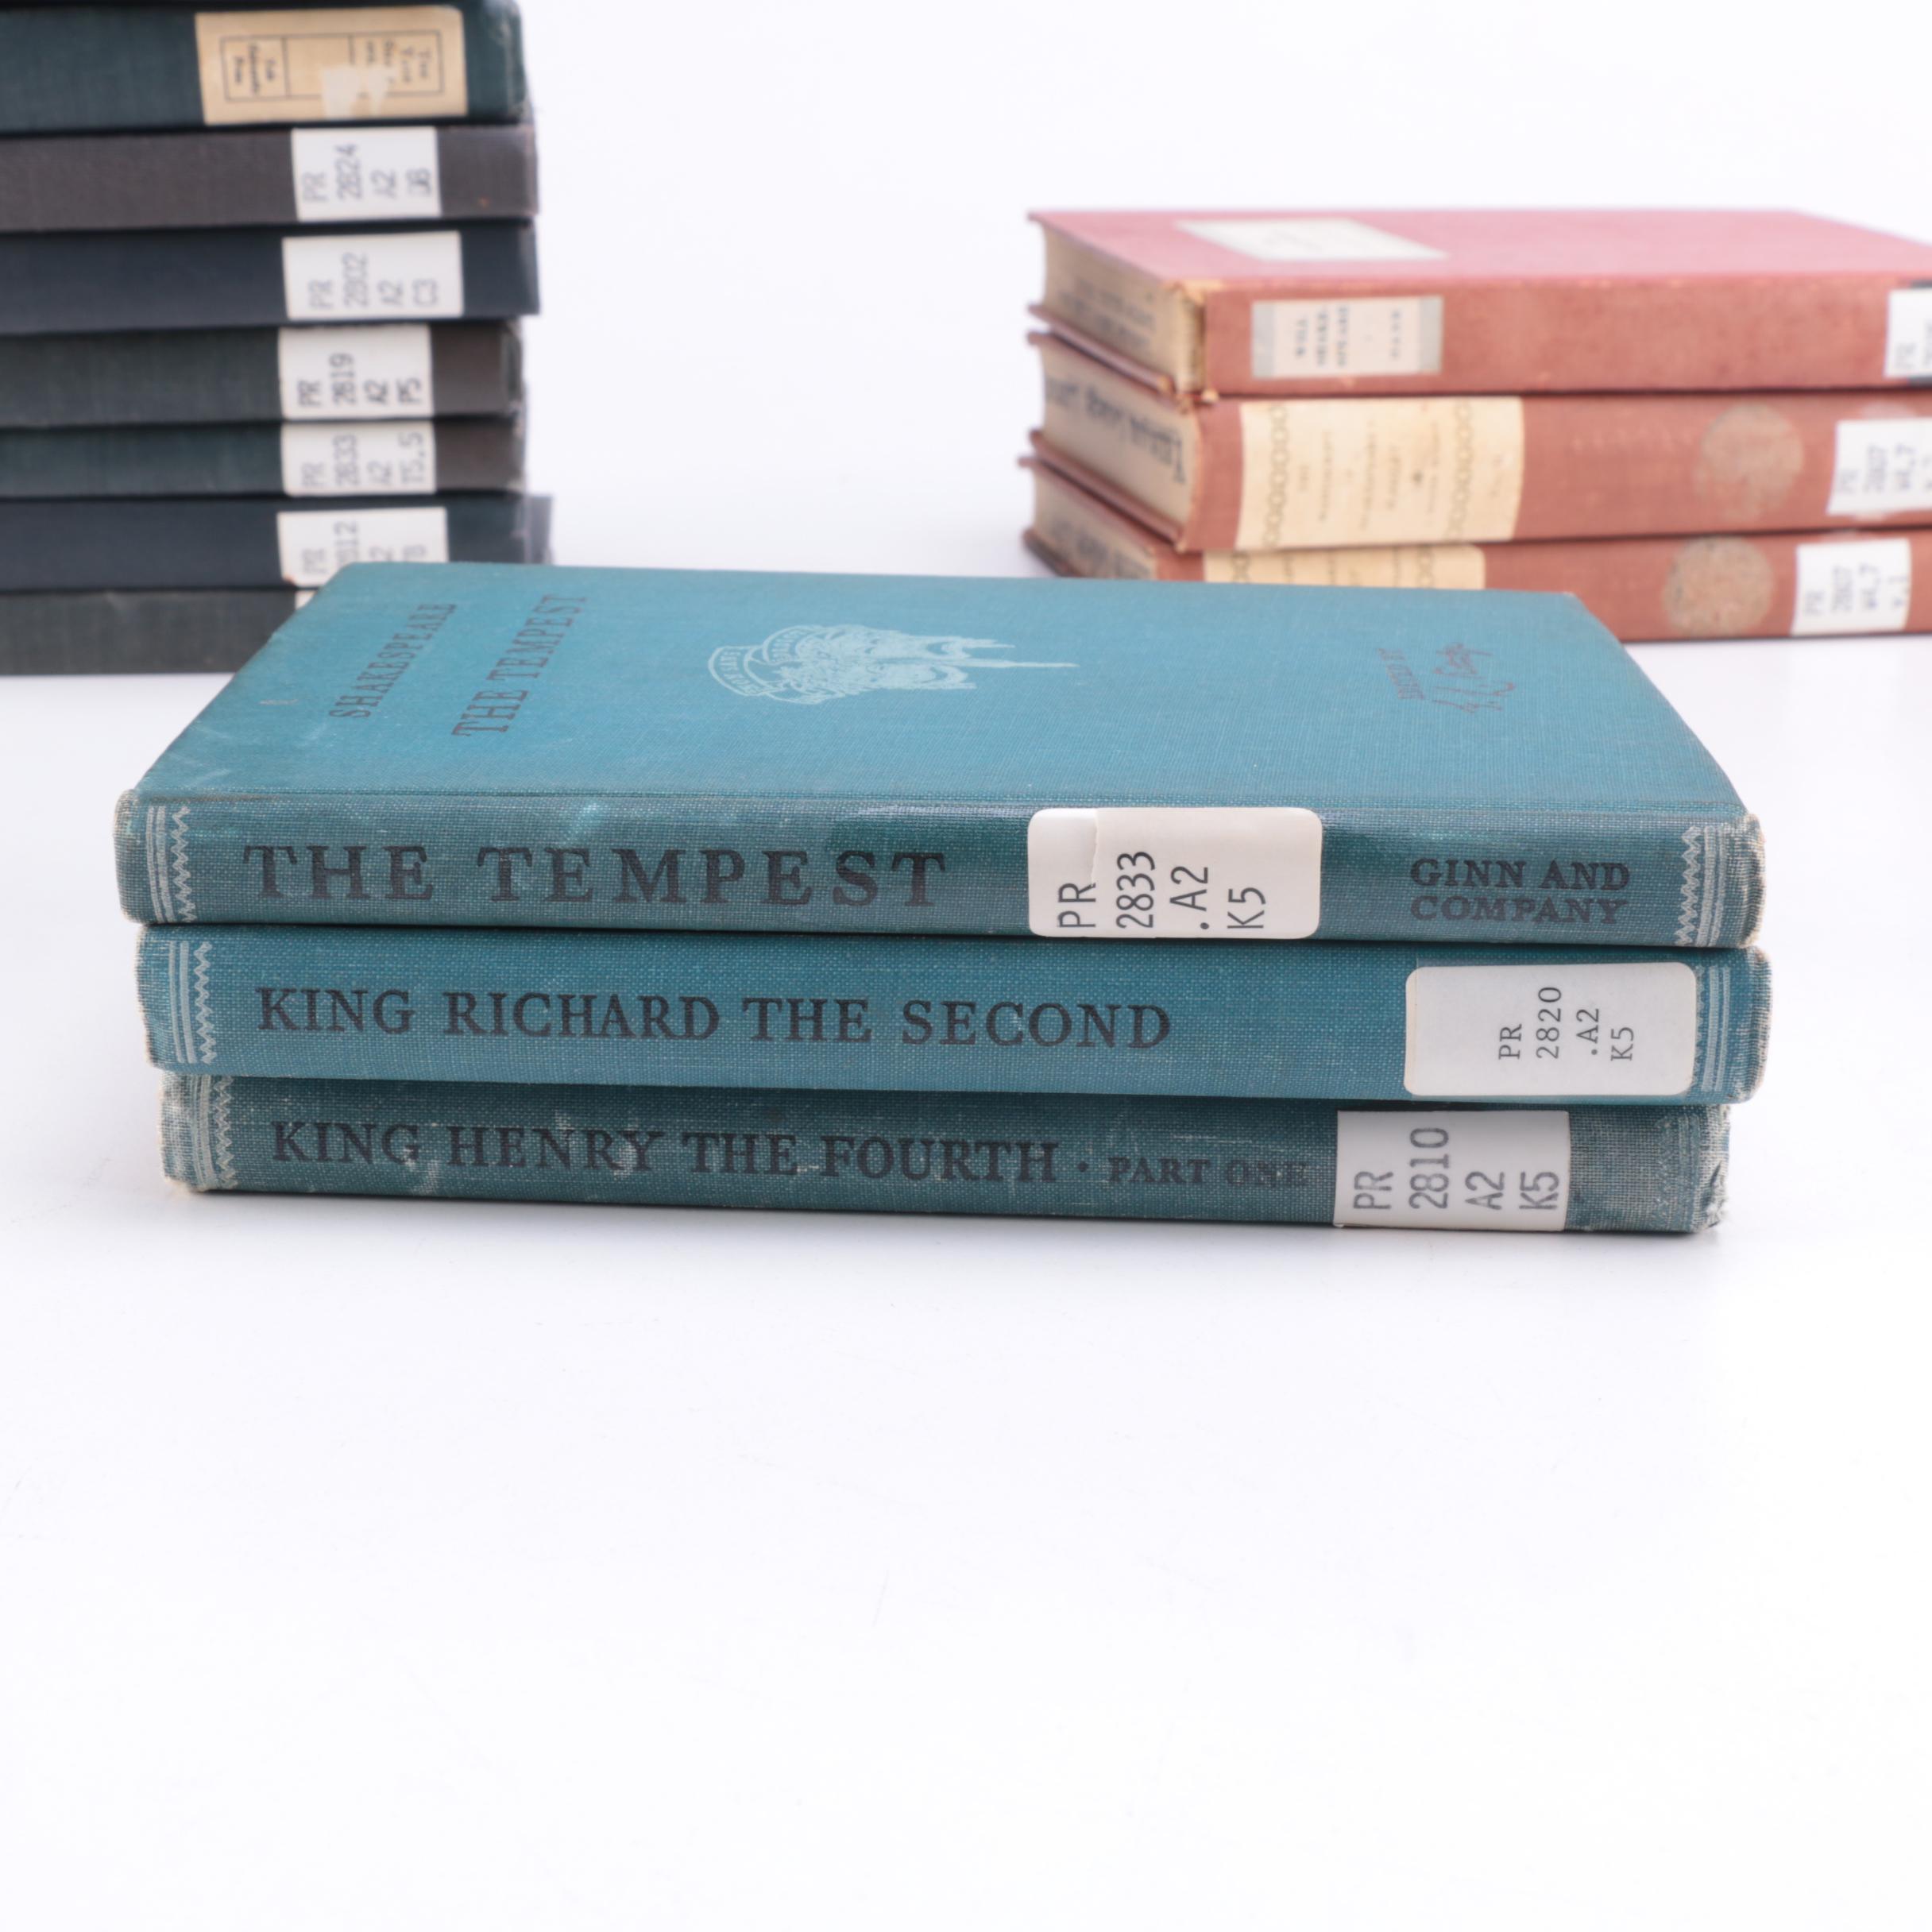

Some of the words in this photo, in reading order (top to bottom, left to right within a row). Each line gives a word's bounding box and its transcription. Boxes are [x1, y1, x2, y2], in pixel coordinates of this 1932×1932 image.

[297, 380, 323, 408] PR
[328, 604, 457, 718] SHAKESPEARE
[485, 593, 588, 682] TEMPEST
[450, 690, 529, 737] THE
[242, 844, 434, 901] THE
[477, 847, 947, 907] TEMPEST
[1115, 851, 1157, 929] 2833
[1410, 858, 1528, 888] GINN
[1540, 860, 1631, 889] AND
[1057, 883, 1097, 928] PR
[1169, 866, 1209, 930] .A2
[1228, 887, 1265, 929] K5
[1410, 895, 1629, 924] COMPANY
[255, 987, 415, 1034] KING
[442, 991, 719, 1041] RICHARD
[741, 996, 874, 1043] THE
[901, 999, 1171, 1049] SECOND
[1536, 986, 1563, 1060] 2820
[1576, 1007, 1600, 1057] .A2
[1497, 1023, 1523, 1061] PR
[1609, 1026, 1635, 1061] K5
[271, 1120, 419, 1165] KING
[446, 1125, 663, 1173] HENRY
[681, 1131, 797, 1177] THE
[819, 1134, 1059, 1184] FOURTH
[1107, 1156, 1215, 1187] PART
[1409, 1126, 1450, 1211] 2810
[1354, 1170, 1394, 1210] PR
[1465, 1171, 1505, 1211] A2
[1520, 1170, 1559, 1211] K5
